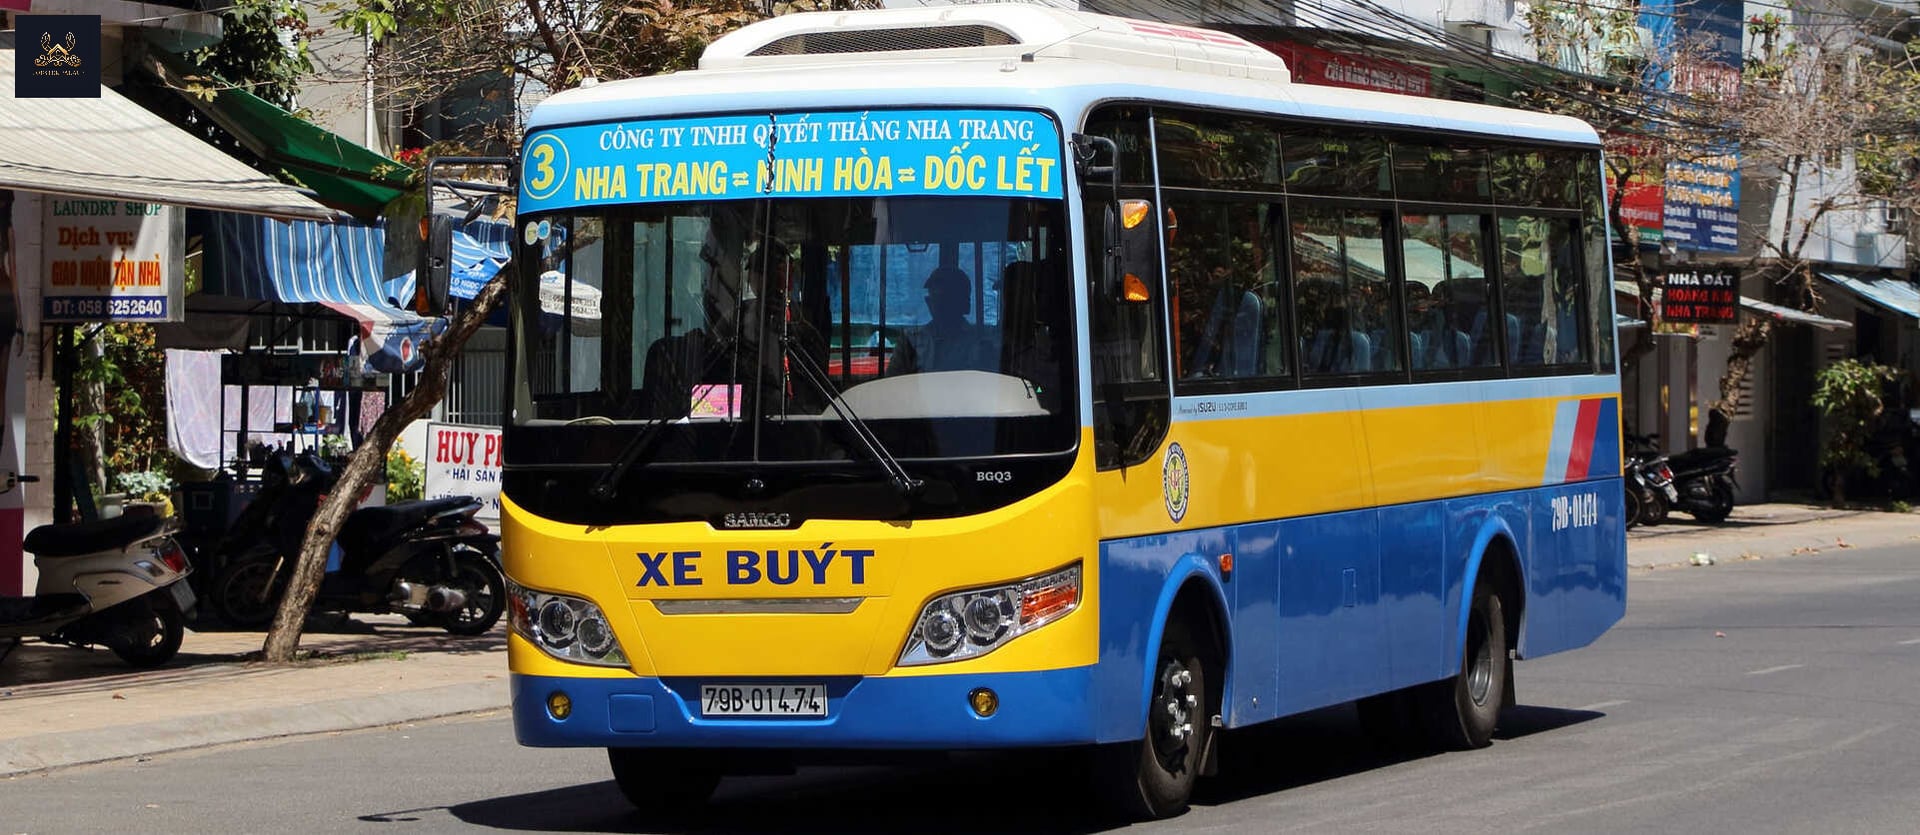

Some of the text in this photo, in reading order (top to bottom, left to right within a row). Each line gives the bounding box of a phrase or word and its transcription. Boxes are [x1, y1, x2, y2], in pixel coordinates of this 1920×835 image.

[600, 110, 1034, 150] CÔNG TY TNHH QUYẾT THẮNG NHA TRANG
[530, 144, 556, 191] 3
[574, 141, 1056, 201] NHA TRANG NINH HÒA DỐC LẾT
[53, 199, 162, 216] LAUNDRY SHOP
[58, 226, 134, 252] Dịch vụ:
[52, 261, 77, 287] GIAO
[113, 254, 135, 291] TẬN
[138, 254, 161, 287] NHÀ
[1668, 270, 1700, 286] NHÀ
[78, 300, 102, 315] 058
[106, 299, 162, 315] 6252640
[1198, 401, 1217, 413] ISUZU
[436, 430, 480, 465] HUY
[976, 471, 1012, 483] BGQ3
[724, 512, 791, 528] SAMCO
[636, 541, 875, 586] XE BUÝT
